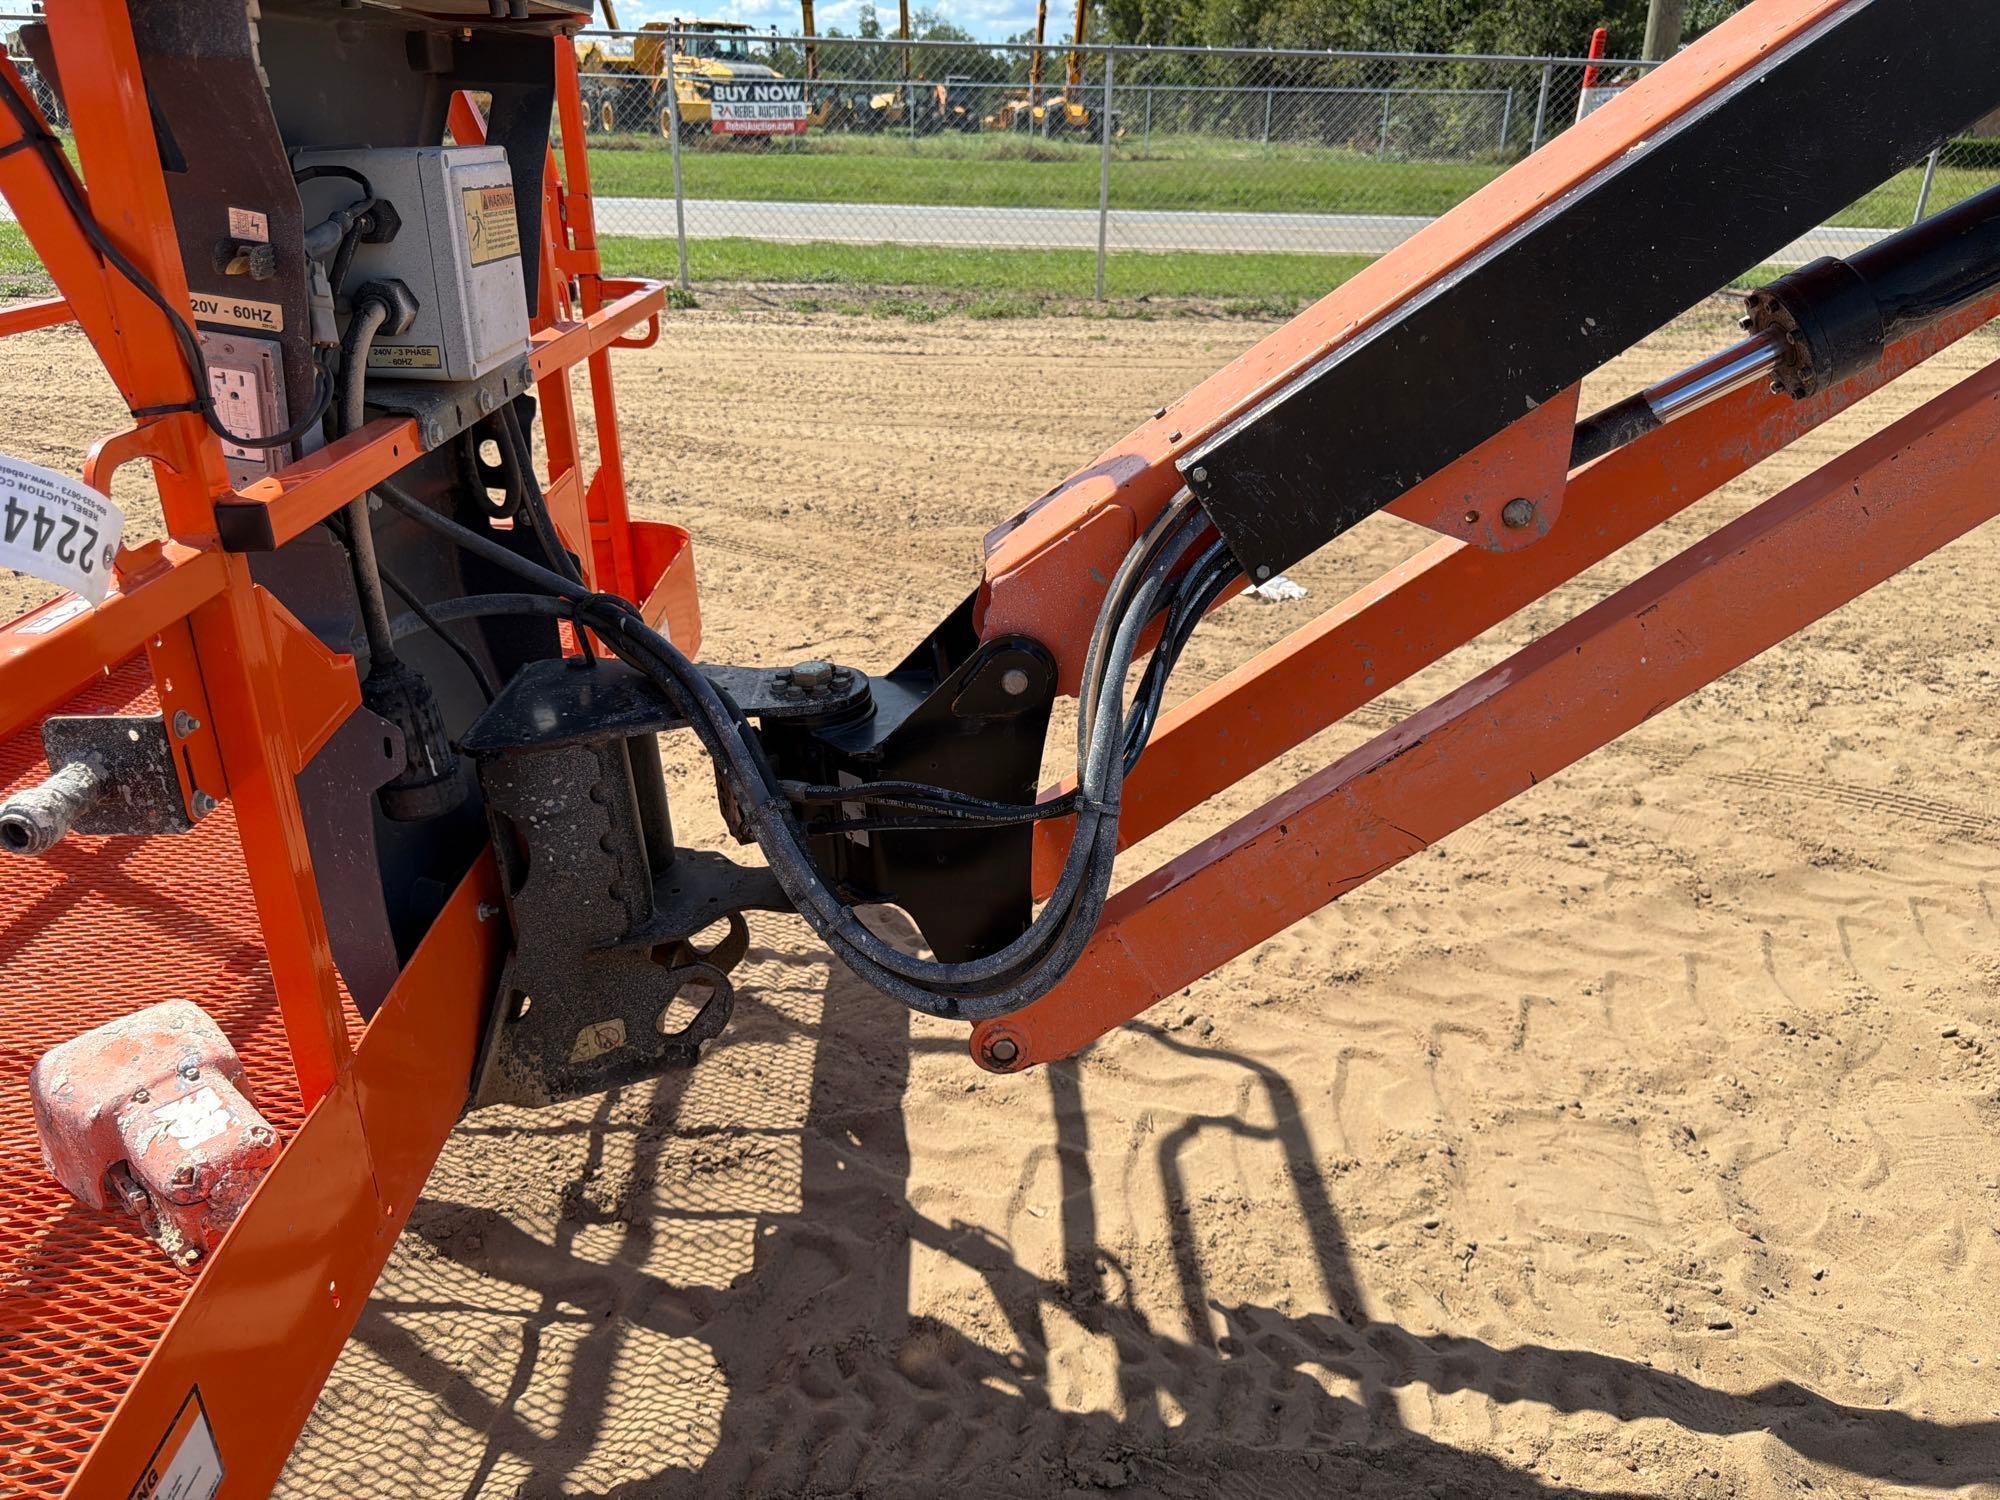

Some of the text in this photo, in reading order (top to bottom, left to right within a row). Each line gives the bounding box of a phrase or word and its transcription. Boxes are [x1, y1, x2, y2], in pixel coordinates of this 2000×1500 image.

[713, 85, 800, 101] BUY NOW
[734, 105, 757, 118] REBEL
[759, 105, 791, 118] AUCTION
[487, 193, 514, 208] WARNING
[190, 299, 219, 315] 20V
[233, 305, 274, 323] 60HZ
[374, 348, 392, 356] 240V
[405, 348, 432, 356] PHASE
[392, 358, 413, 366] 60HZ
[18, 483, 69, 506] AUCTION
[71, 502, 99, 521] REBEL
[4, 496, 99, 574] 2244
[964, 812, 985, 821] Flame
[986, 814, 1018, 822] Resistant
[1019, 812, 1040, 821] MSHA
